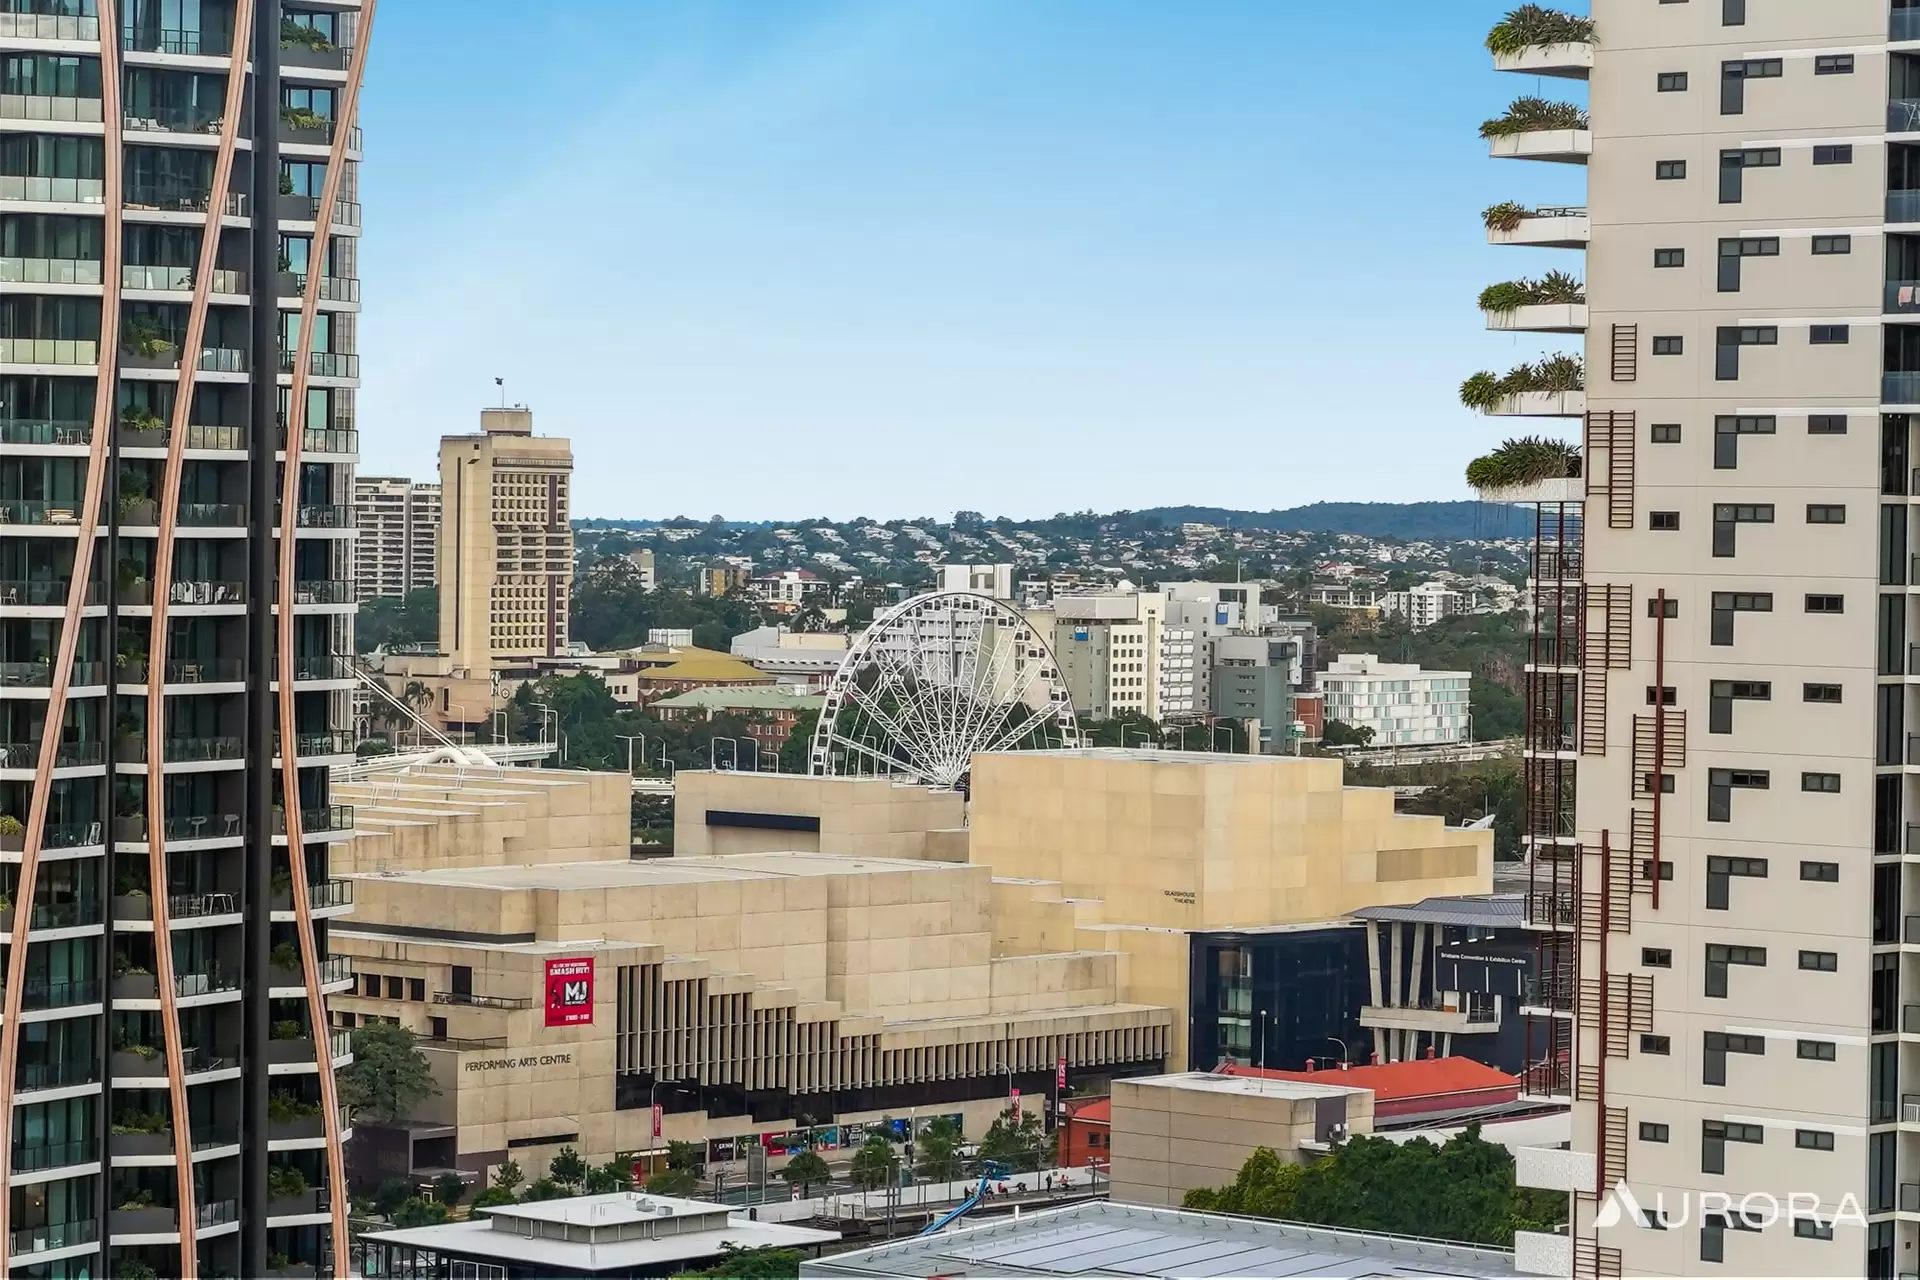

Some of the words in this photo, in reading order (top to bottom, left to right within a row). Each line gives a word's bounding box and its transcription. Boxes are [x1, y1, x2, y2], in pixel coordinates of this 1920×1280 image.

[565, 981, 588, 1001] MJ
[465, 1059, 516, 1072] PERFORMING
[518, 1057, 538, 1067] ARTS
[540, 1054, 571, 1066] CENTRE
